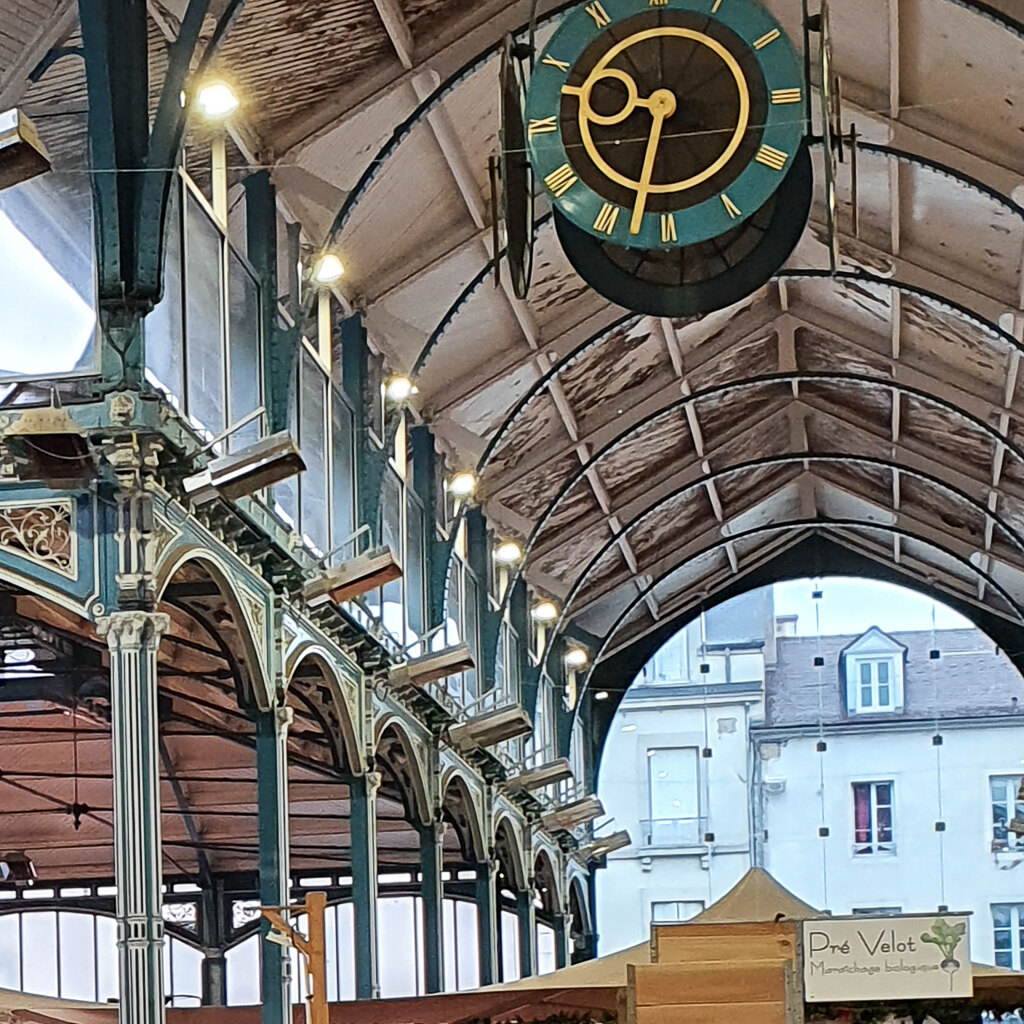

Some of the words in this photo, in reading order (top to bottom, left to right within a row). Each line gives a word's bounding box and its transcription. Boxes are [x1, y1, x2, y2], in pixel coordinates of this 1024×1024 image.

[585, 1, 612, 29] XI
[753, 28, 781, 51] II
[542, 53, 570, 72] X
[771, 87, 802, 105] III
[720, 193, 741, 220] V
[660, 213, 678, 243] VI
[809, 931, 851, 958] Pré
[856, 930, 917, 957] Velot
[884, 958, 940, 975] biologique
